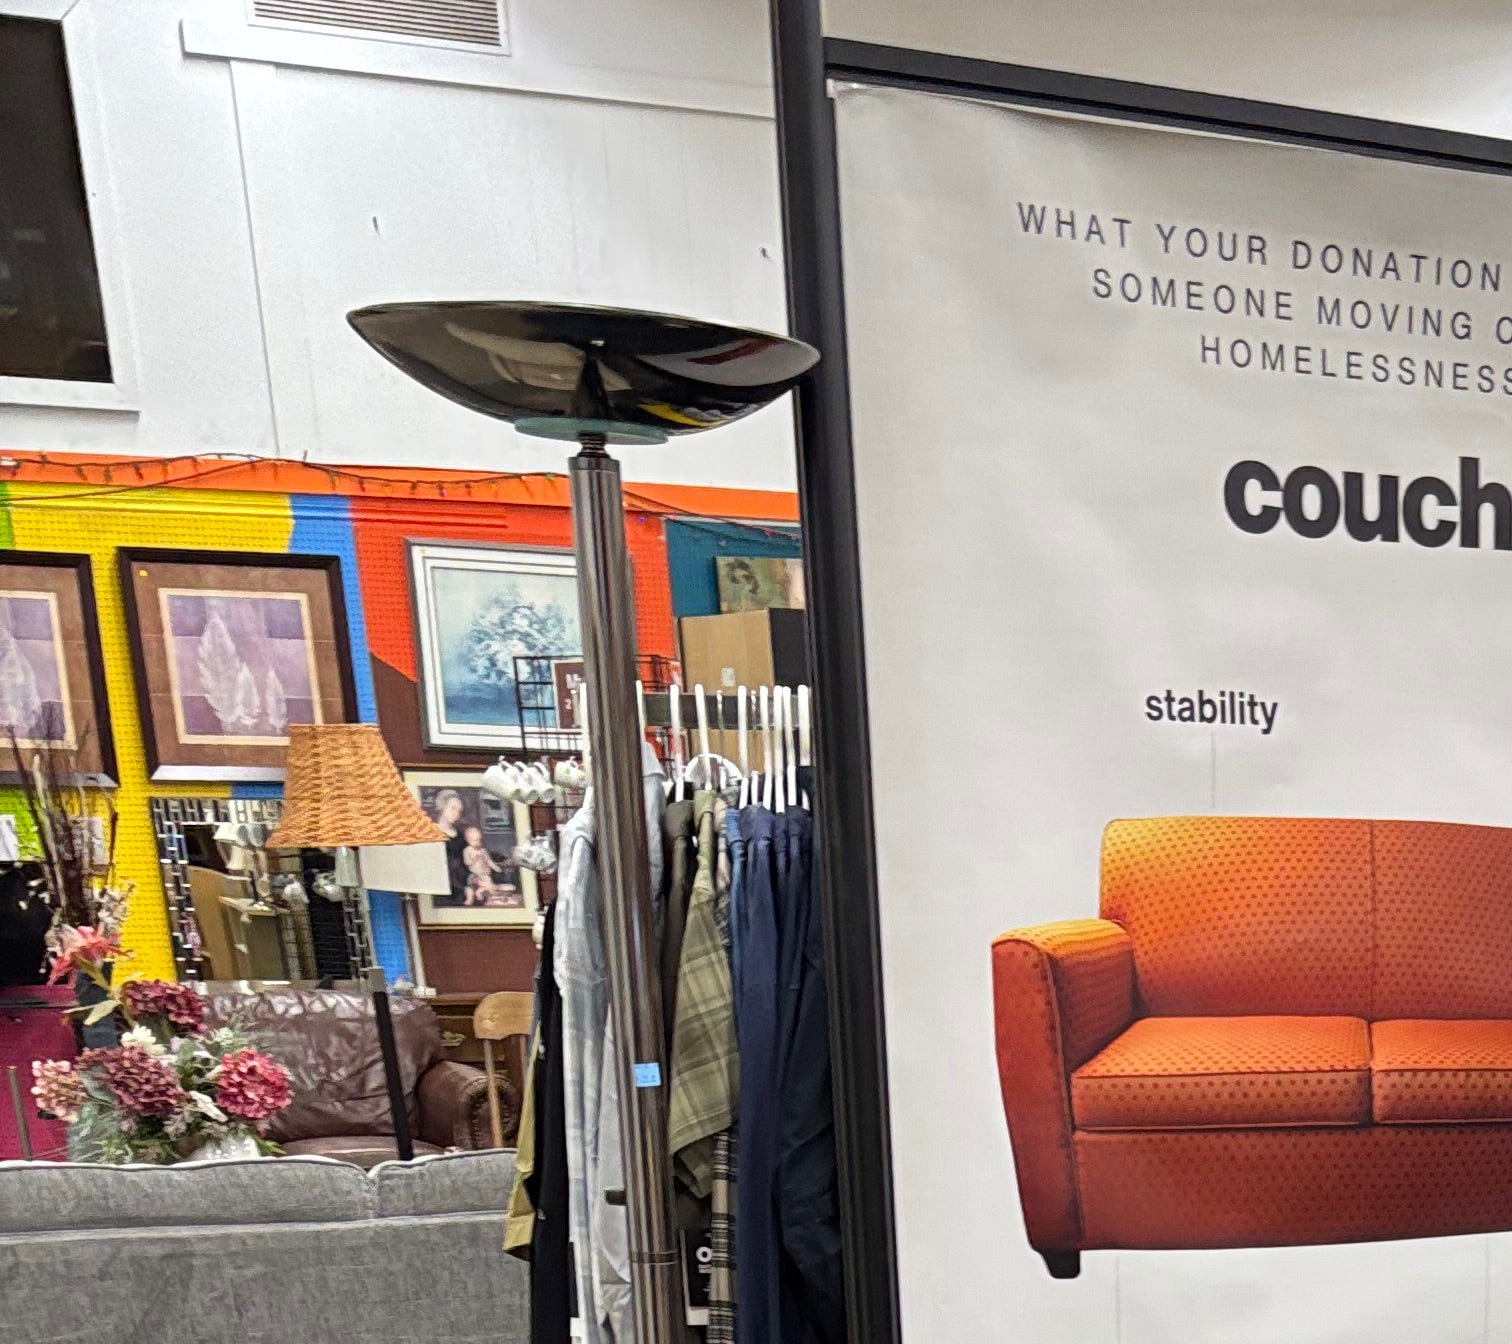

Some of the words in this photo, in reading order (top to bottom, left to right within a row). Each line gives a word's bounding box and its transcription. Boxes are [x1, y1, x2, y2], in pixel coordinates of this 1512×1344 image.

[1018, 202, 1131, 247] WHAT
[1156, 224, 1266, 265] YOUR
[1291, 240, 1501, 292] DONATION
[1093, 269, 1292, 320] SOMEONE
[1318, 296, 1472, 340] MOVING
[1145, 688, 1279, 735] stability
